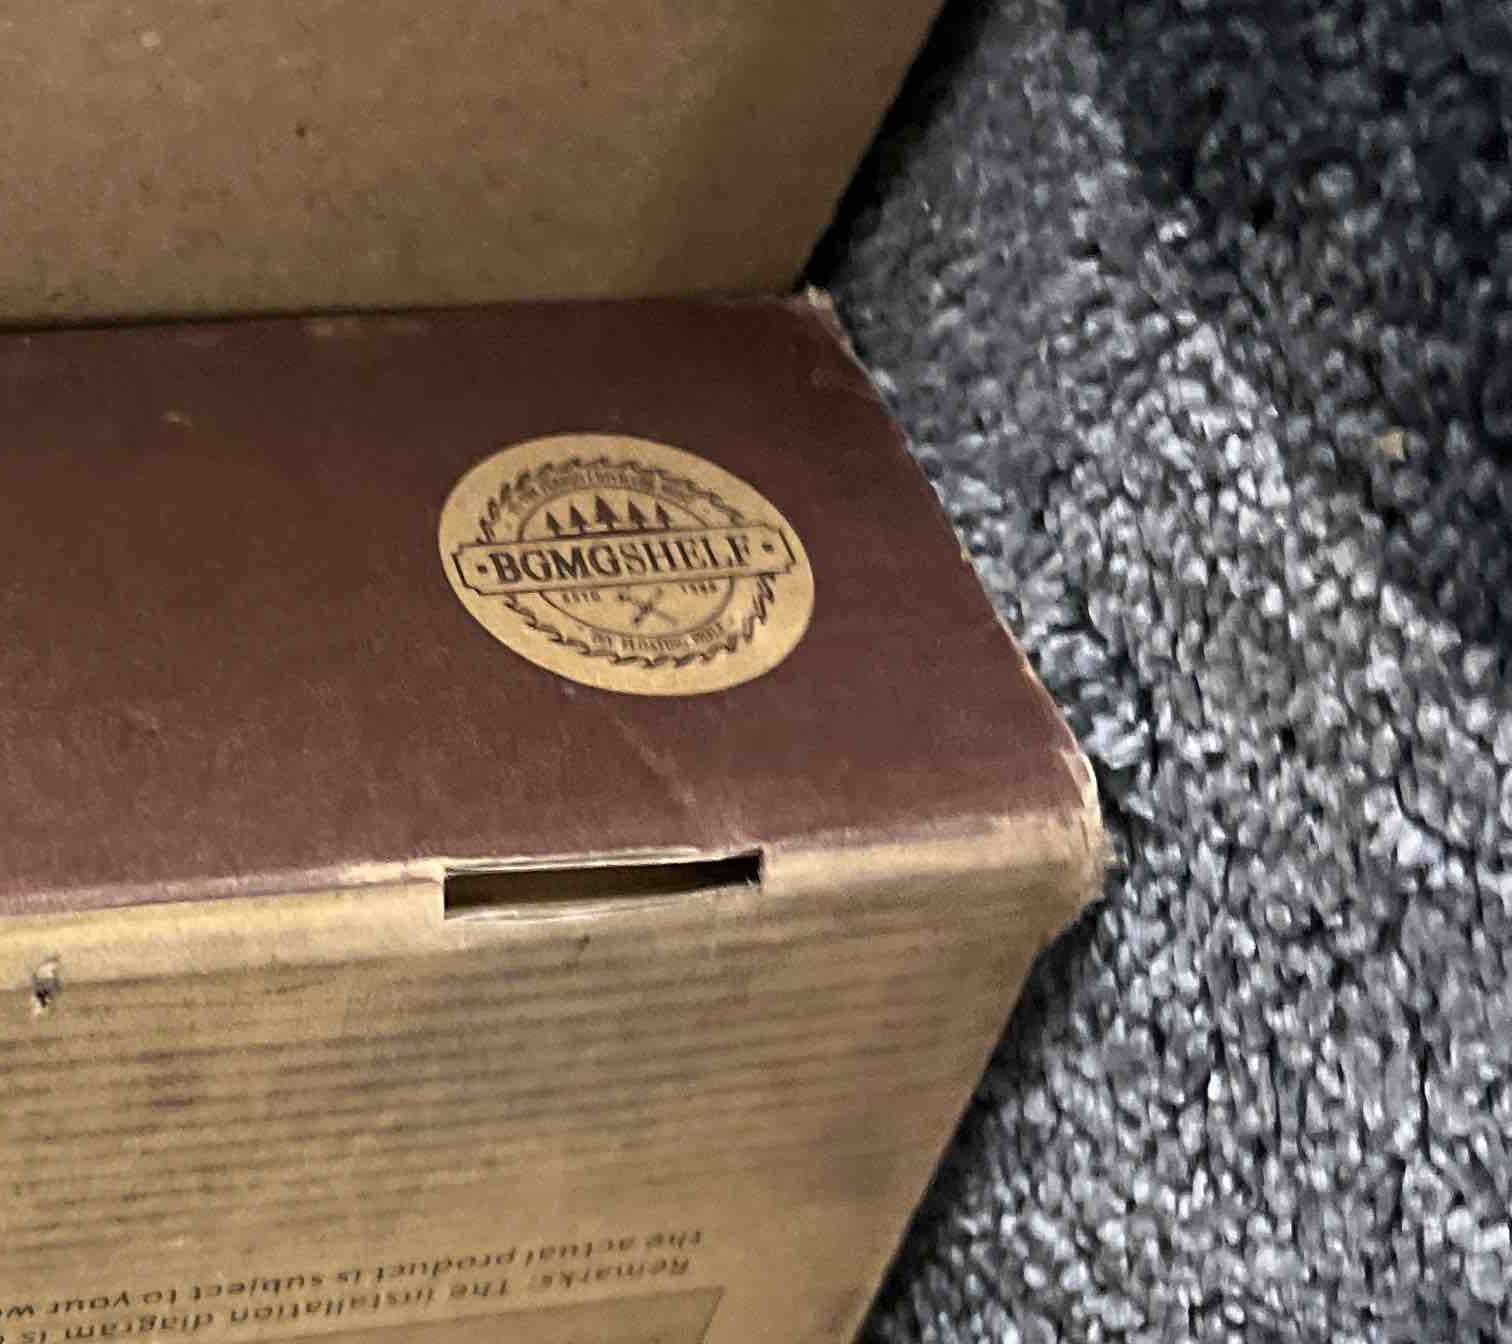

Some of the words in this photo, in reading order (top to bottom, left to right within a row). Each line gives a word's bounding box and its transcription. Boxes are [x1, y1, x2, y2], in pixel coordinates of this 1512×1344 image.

[524, 1239, 635, 1267] actual
[644, 1231, 701, 1250] the
[335, 1269, 361, 1286] is
[375, 1247, 517, 1284] product
[142, 1289, 178, 1307] to
[192, 1273, 324, 1301] subject
[448, 1278, 508, 1299] The
[46, 1290, 132, 1315] your
[228, 1287, 435, 1326] installation
[63, 1312, 214, 1342] diagram
